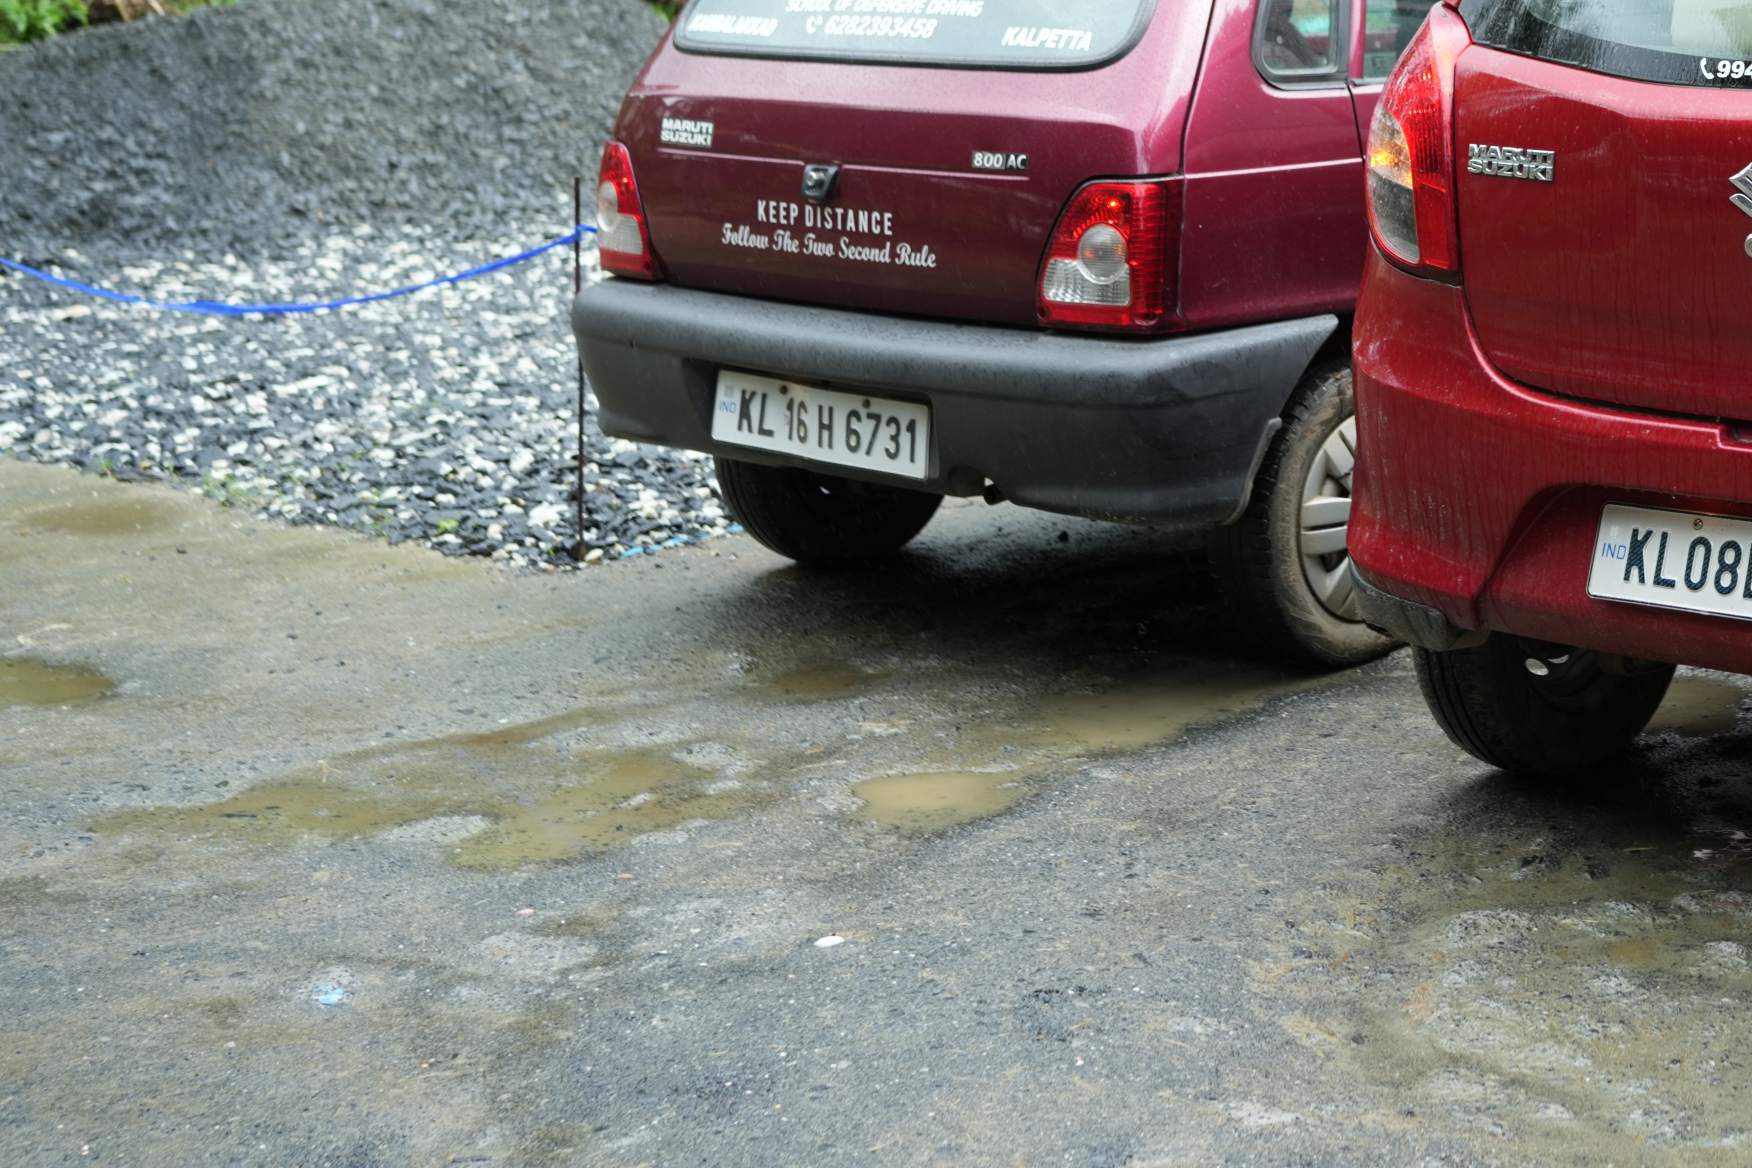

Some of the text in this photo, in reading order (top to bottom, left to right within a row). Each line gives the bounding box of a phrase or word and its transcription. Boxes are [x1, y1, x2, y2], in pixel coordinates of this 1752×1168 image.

[926, 0, 985, 17] DRIVING
[823, 14, 938, 39] 6282393458
[1001, 25, 1093, 52] KALPETTA
[662, 118, 714, 135] MARUTI
[661, 130, 712, 146] SUZUKI
[973, 152, 1028, 169] 800 AC
[1468, 143, 1556, 164] MARUTI
[1467, 159, 1554, 182] SUZUKI
[757, 199, 893, 236] KEEP DISTANCE
[721, 223, 937, 268] Follow The Two Second Rule
[719, 399, 737, 414] IND
[737, 388, 917, 464] KL 16 H 6731
[1600, 542, 1627, 561] IND
